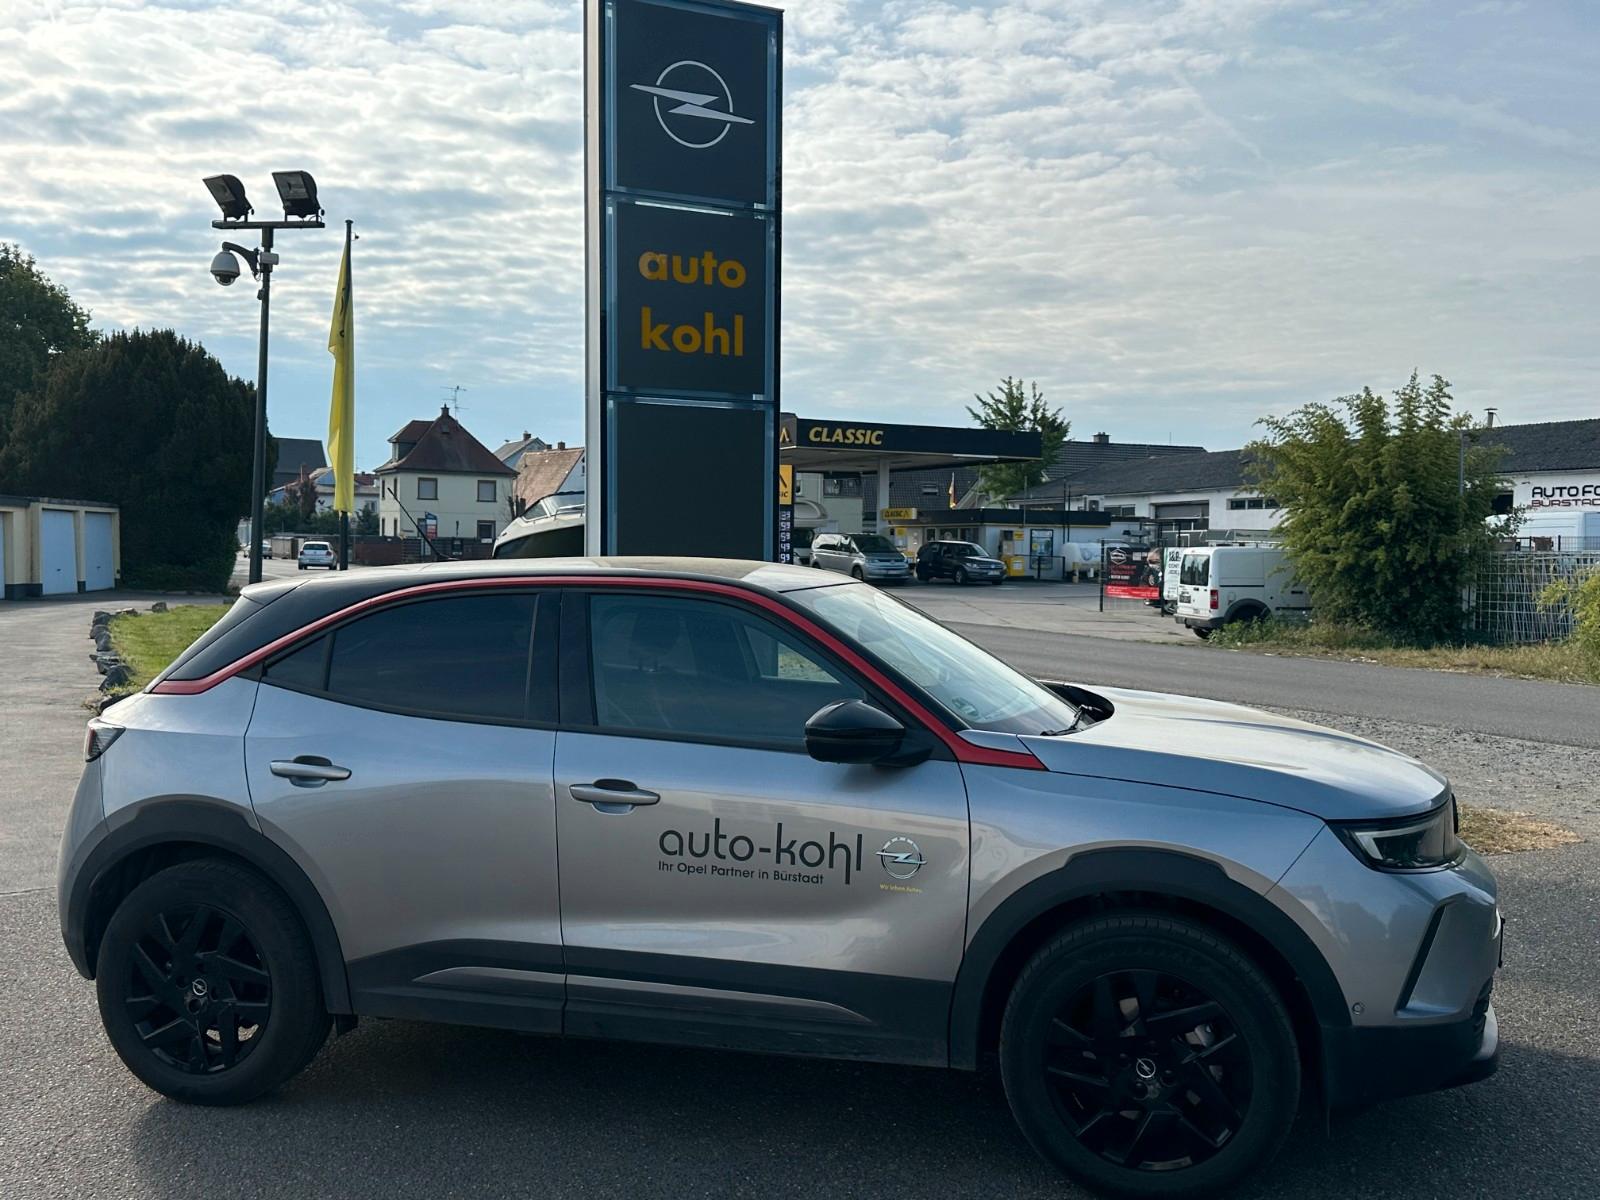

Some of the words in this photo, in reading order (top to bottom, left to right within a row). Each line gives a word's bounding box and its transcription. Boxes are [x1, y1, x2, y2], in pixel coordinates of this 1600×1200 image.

[638, 251, 747, 289] auto
[641, 306, 744, 357] kohl
[808, 426, 884, 446] CLASSIC
[1532, 486, 1579, 498] AUTO
[658, 817, 863, 885] auto-kohl
[658, 861, 673, 872] Ihr
[677, 862, 707, 876] Opel
[711, 865, 755, 879] Partner
[758, 870, 769, 880] in
[773, 870, 824, 885] Bürstadt
